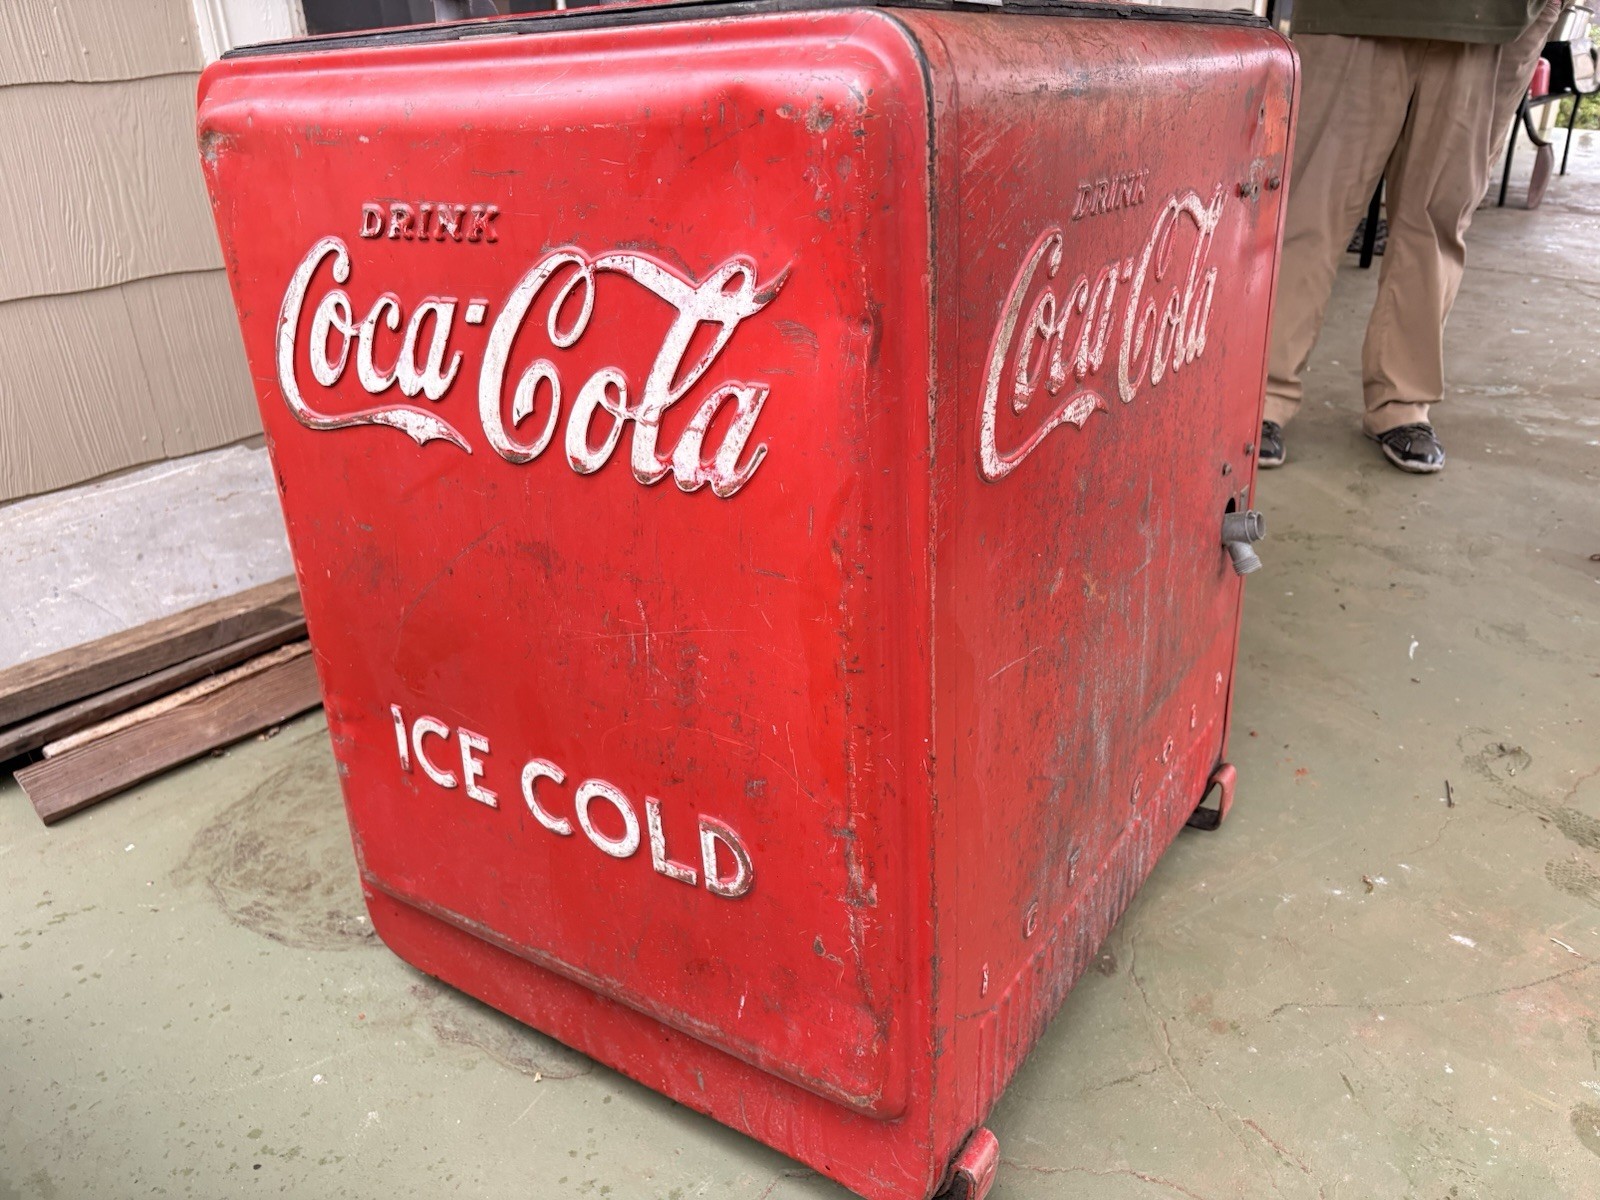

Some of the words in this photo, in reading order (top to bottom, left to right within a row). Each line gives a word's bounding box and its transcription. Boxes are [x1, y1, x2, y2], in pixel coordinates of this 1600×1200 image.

[359, 202, 500, 243] DRINK
[1072, 168, 1150, 221] DRINK
[275, 235, 793, 499] Coca-Cola
[975, 182, 1229, 483] Coca-Cola
[390, 702, 499, 809] ICE
[520, 757, 754, 899] COLD
